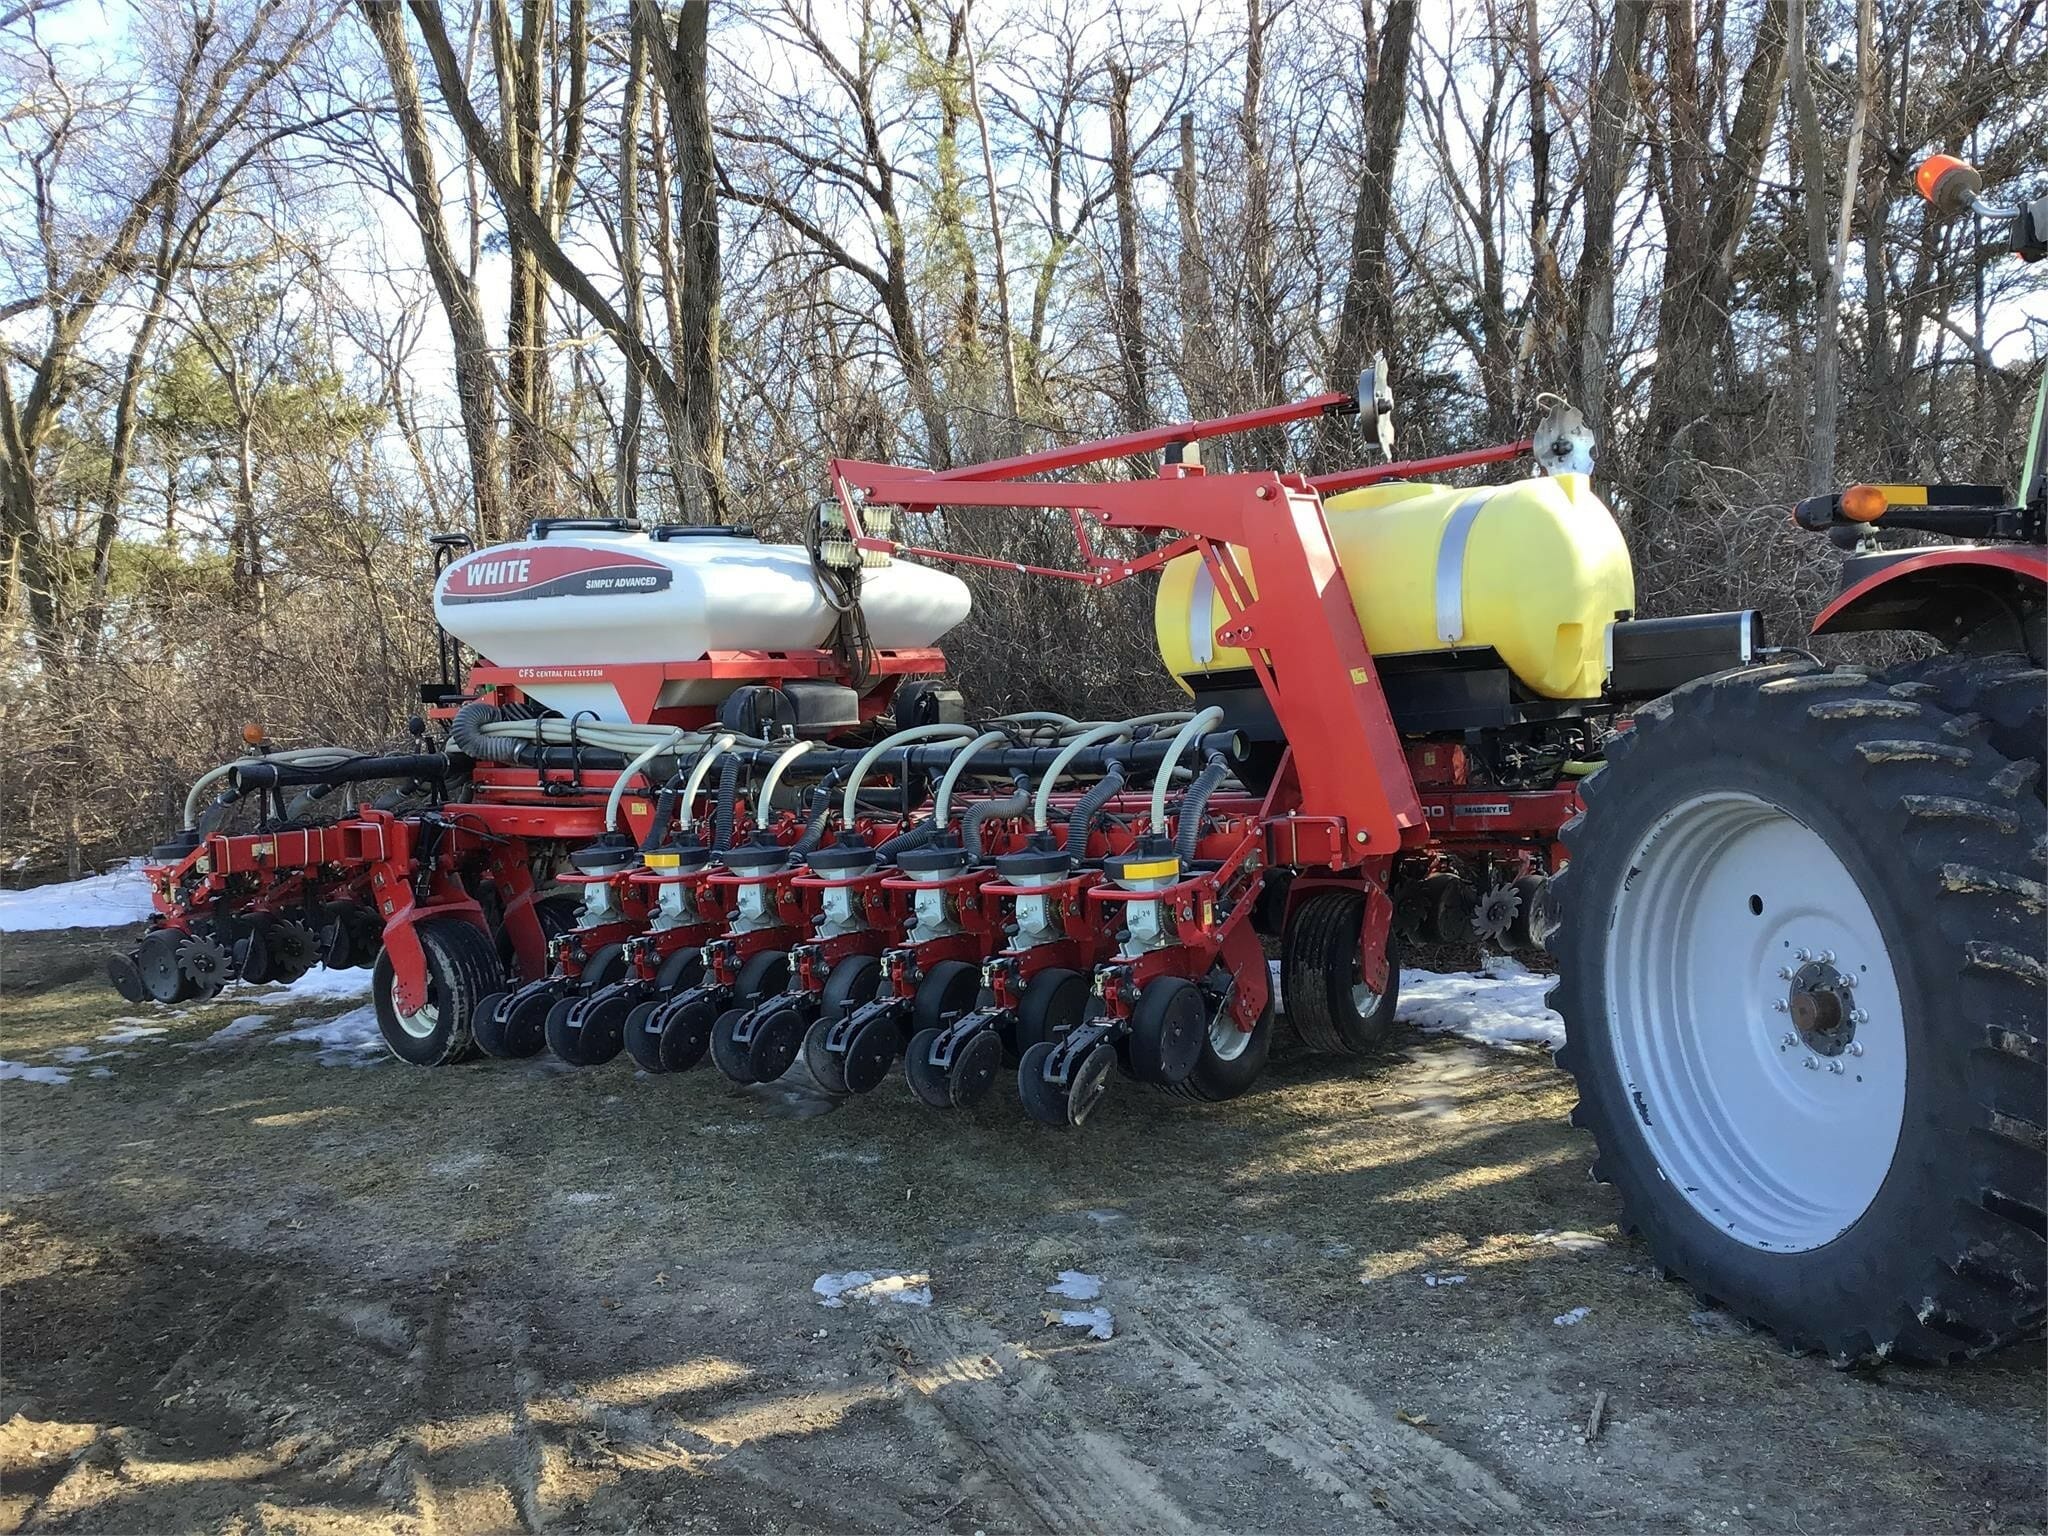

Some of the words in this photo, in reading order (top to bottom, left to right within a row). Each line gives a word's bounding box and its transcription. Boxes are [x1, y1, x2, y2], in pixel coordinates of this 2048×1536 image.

[467, 559, 531, 586] WHITE
[585, 579, 613, 590] SIMPLY
[614, 576, 657, 588] ADVANCED
[518, 668, 535, 678] CFS
[536, 670, 562, 678] CENTRAL
[563, 670, 577, 678] FILL
[578, 669, 603, 677] SYSTEM
[1464, 806, 1497, 814] MASSEY
